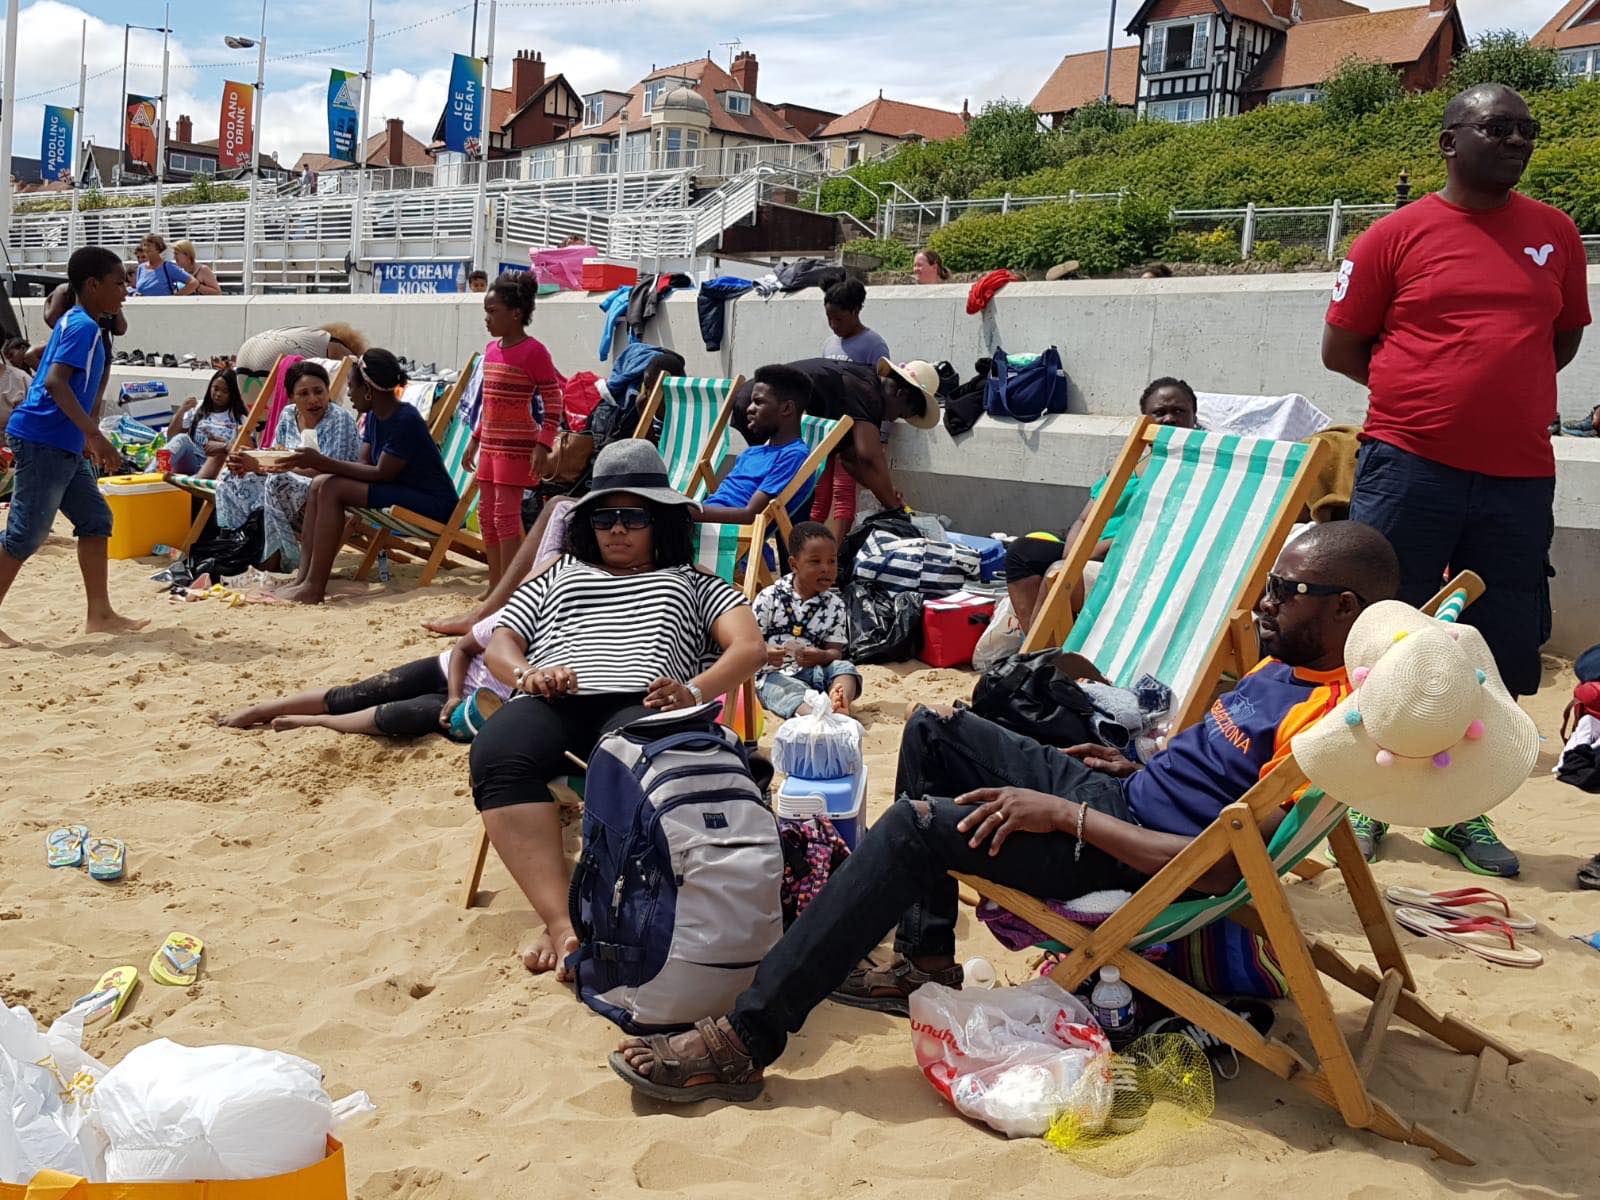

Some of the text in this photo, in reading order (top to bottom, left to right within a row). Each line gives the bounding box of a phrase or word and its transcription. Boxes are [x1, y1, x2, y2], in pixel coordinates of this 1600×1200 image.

[454, 91, 464, 116] ICE
[463, 80, 476, 132] CREAM
[226, 91, 238, 157] FOOD AND
[235, 107, 246, 145] DRINK
[48, 115, 59, 171] PADDLING
[57, 127, 66, 163] POOLS
[385, 264, 454, 280] ICE CREAM
[398, 281, 438, 294] KIOSK
